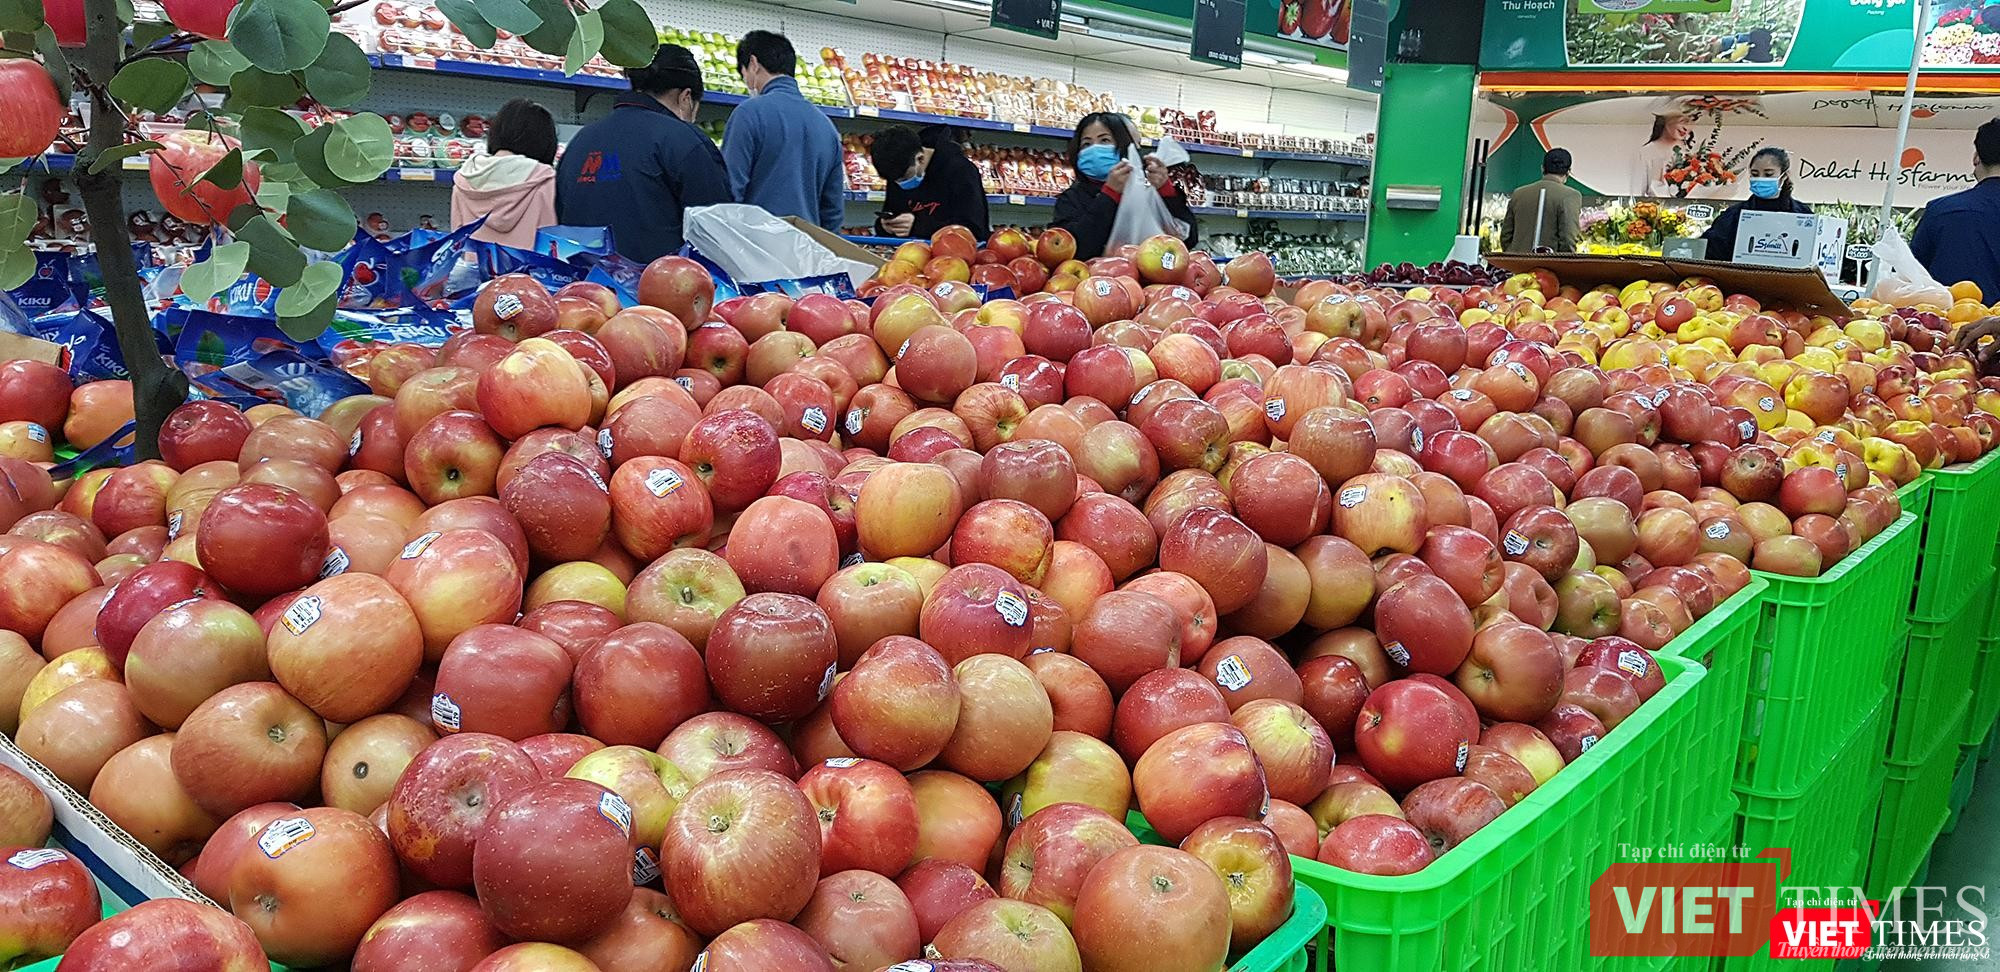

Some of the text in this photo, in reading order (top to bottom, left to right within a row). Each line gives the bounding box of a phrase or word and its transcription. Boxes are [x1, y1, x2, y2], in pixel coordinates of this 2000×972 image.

[1502, 0, 1555, 11] Thu Hoạch
[1800, 158, 1975, 187] Dalat Hsfarm
[18, 297, 51, 306] KIKU
[96, 353, 129, 376] KIKU
